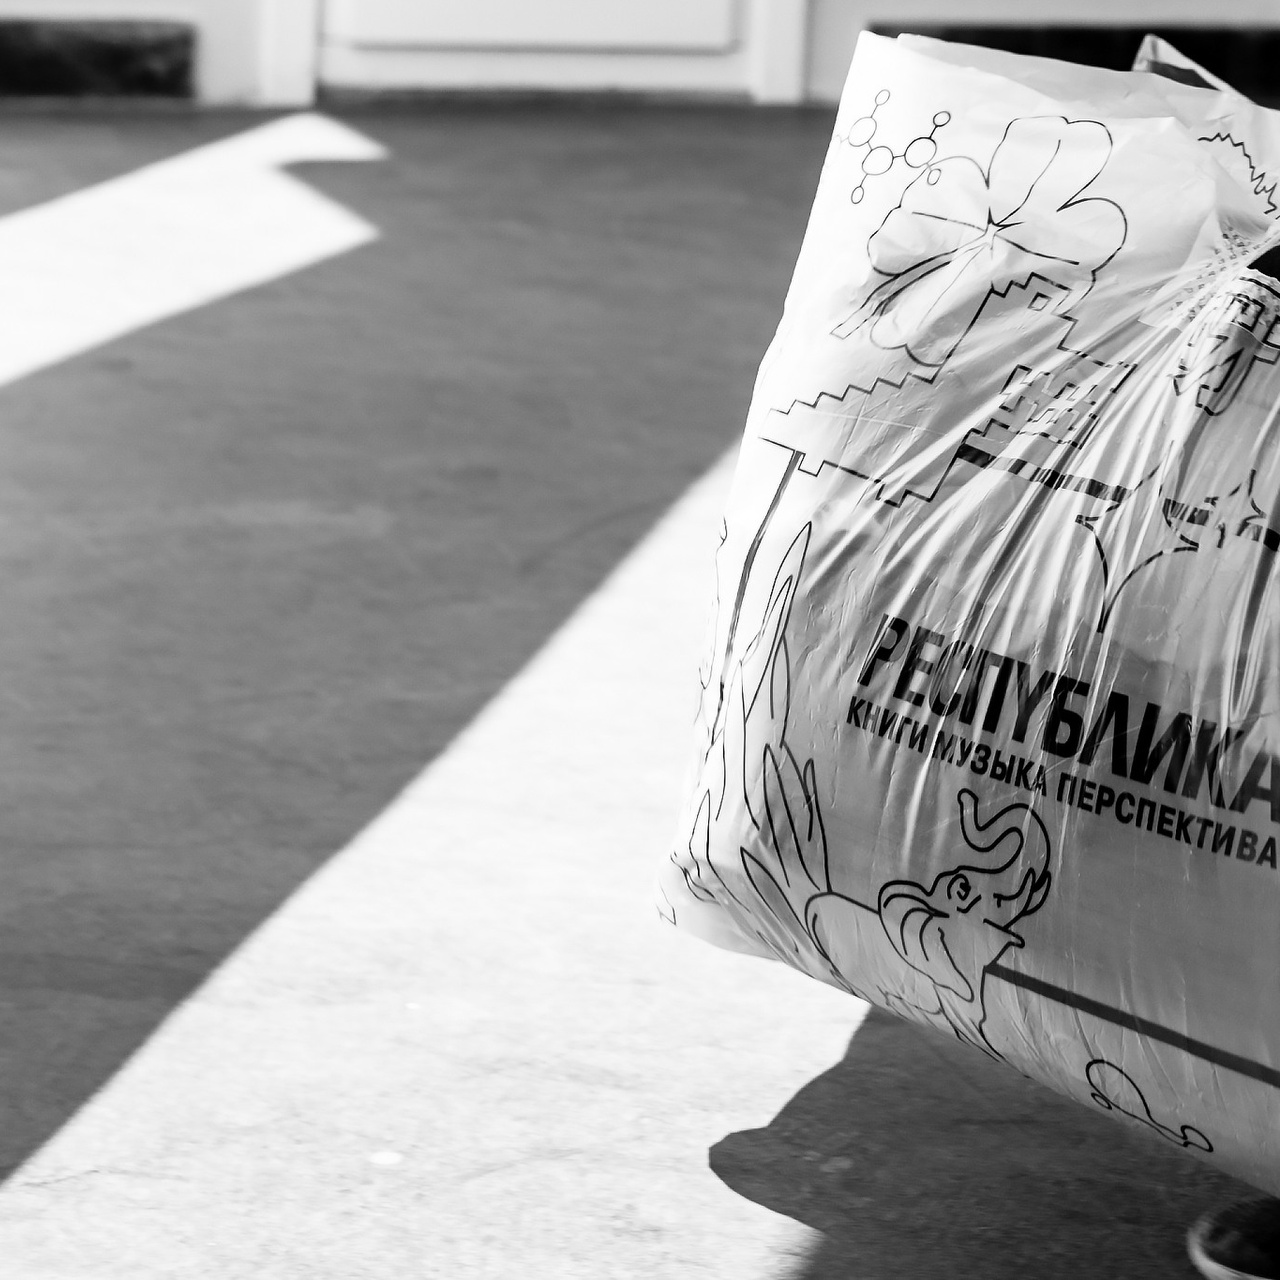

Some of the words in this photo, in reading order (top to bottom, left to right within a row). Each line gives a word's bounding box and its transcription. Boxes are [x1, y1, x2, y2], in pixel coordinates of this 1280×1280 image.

[846, 695, 929, 754] КНИГИ
[931, 730, 1047, 797] МУЗЫКА
[1056, 772, 1278, 870] ПЕРСПЕКТИВА
